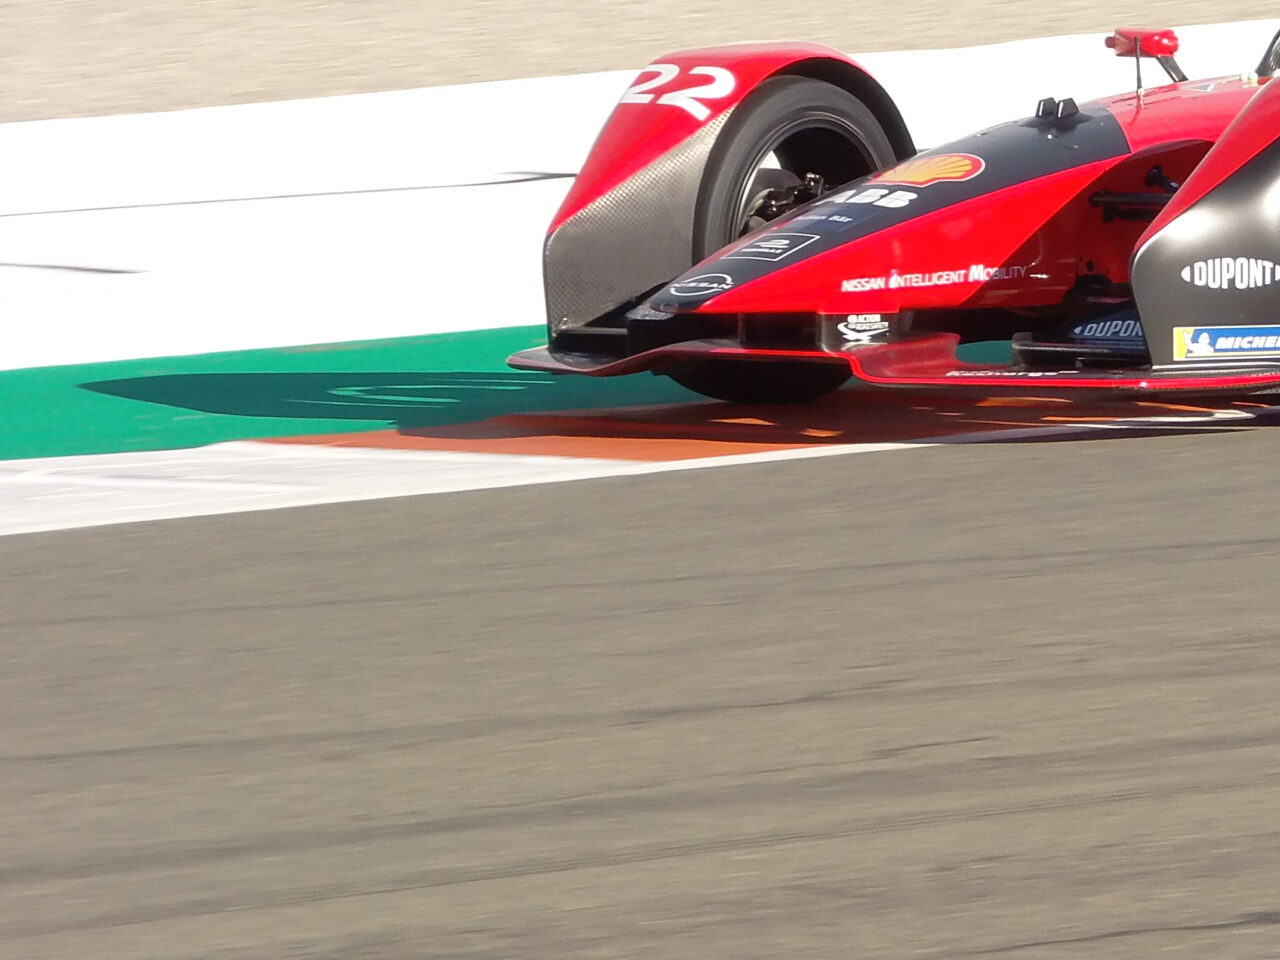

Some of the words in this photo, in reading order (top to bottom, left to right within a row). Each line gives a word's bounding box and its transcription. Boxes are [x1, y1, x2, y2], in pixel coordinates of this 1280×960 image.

[619, 63, 736, 121] 22
[811, 188, 918, 208] ABB
[1193, 257, 1274, 289] DUPONT
[841, 277, 886, 292] NISSAN
[1083, 320, 1142, 337] DUPON
